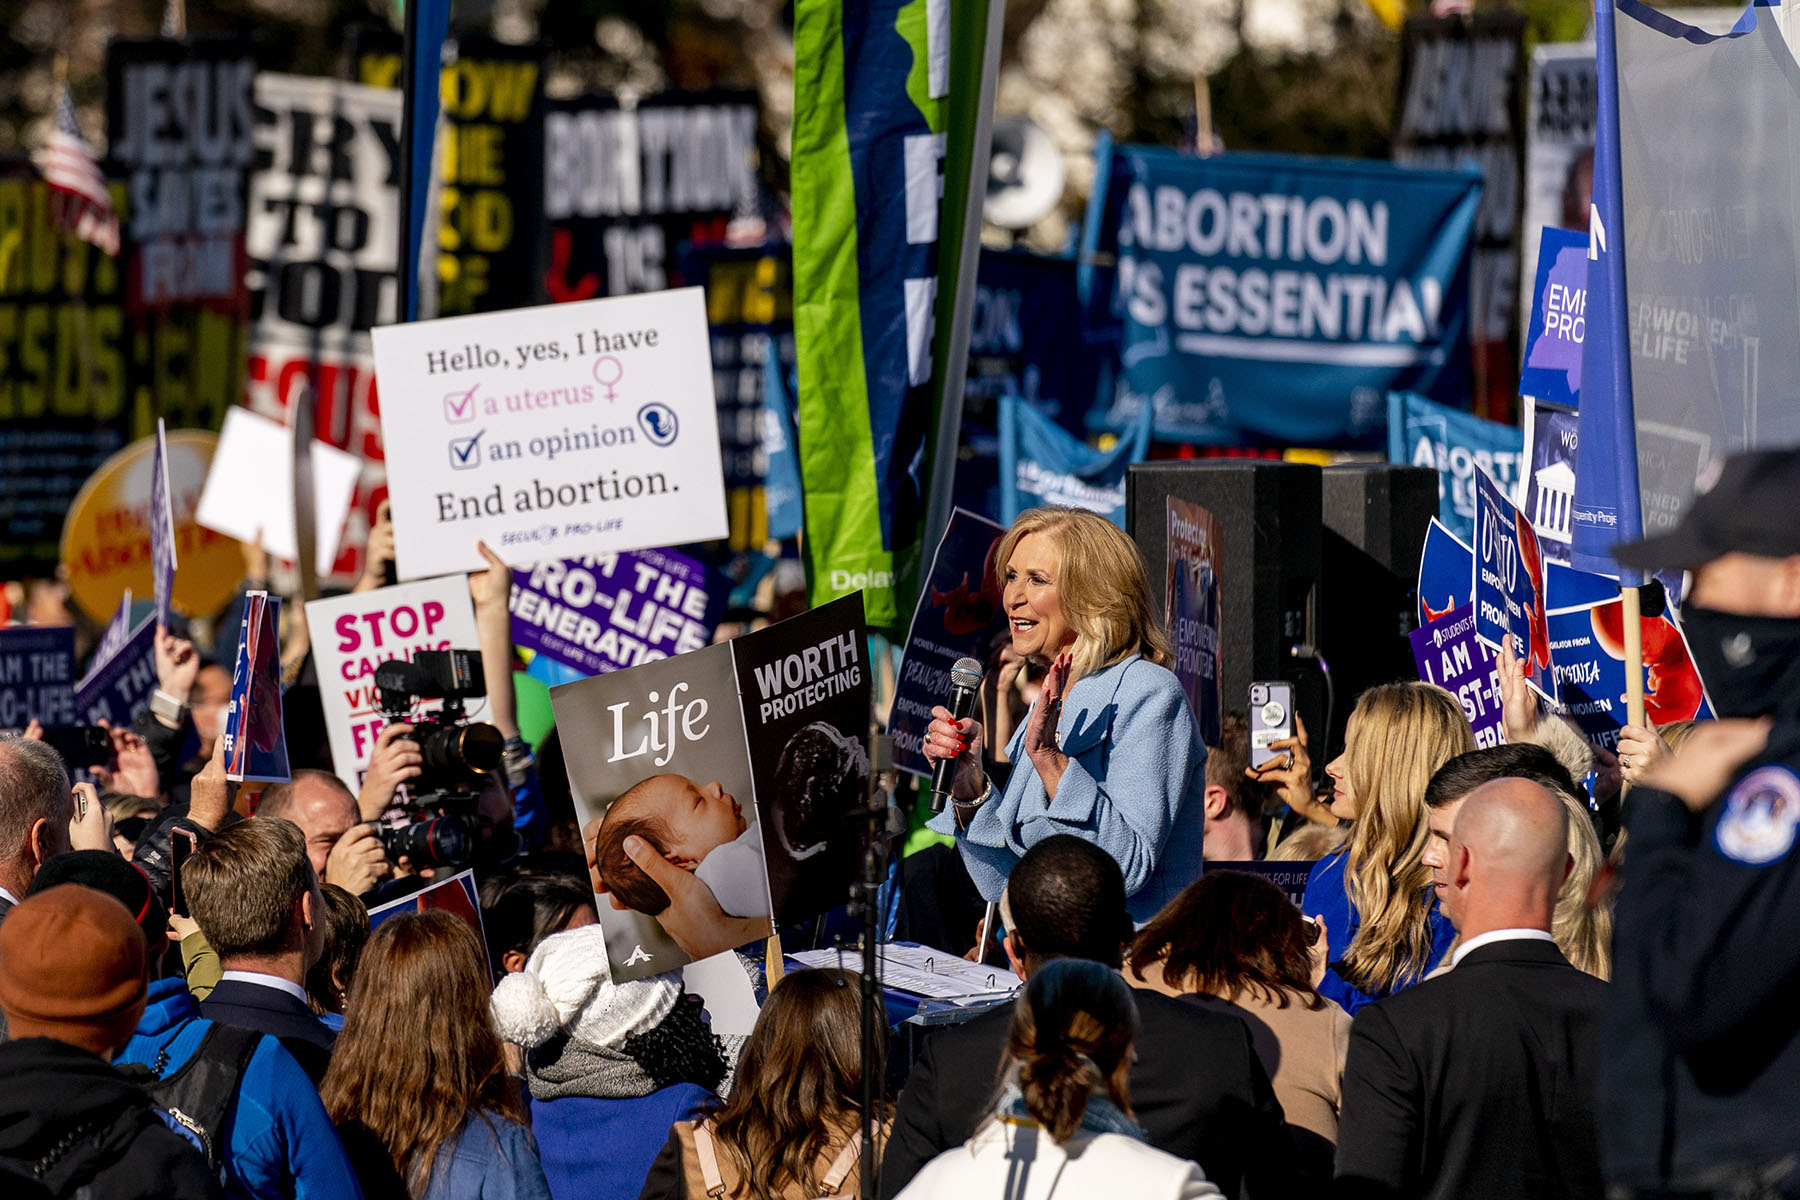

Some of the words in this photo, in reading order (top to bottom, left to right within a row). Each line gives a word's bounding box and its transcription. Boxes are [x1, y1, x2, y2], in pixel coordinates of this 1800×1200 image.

[1119, 184, 1391, 266] ABORTION
[427, 344, 510, 375] Hello,
[516, 339, 569, 369] yes,
[576, 333, 586, 355] I
[593, 328, 659, 354] have
[484, 397, 499, 416] a
[506, 382, 594, 413] uterus
[489, 440, 522, 461] an
[528, 424, 636, 460] opinion
[436, 484, 505, 523] End
[515, 470, 681, 514] abortion.
[633, 560, 709, 620] THE
[335, 601, 445, 654] STOP
[1572, 636, 1591, 647] FROM
[30, 653, 70, 682] THE
[754, 630, 859, 700] WORTH
[1441, 641, 1473, 683] AM
[760, 666, 861, 724] PROTECTING
[1571, 698, 1613, 716] WOMEN
[607, 682, 710, 767] Life
